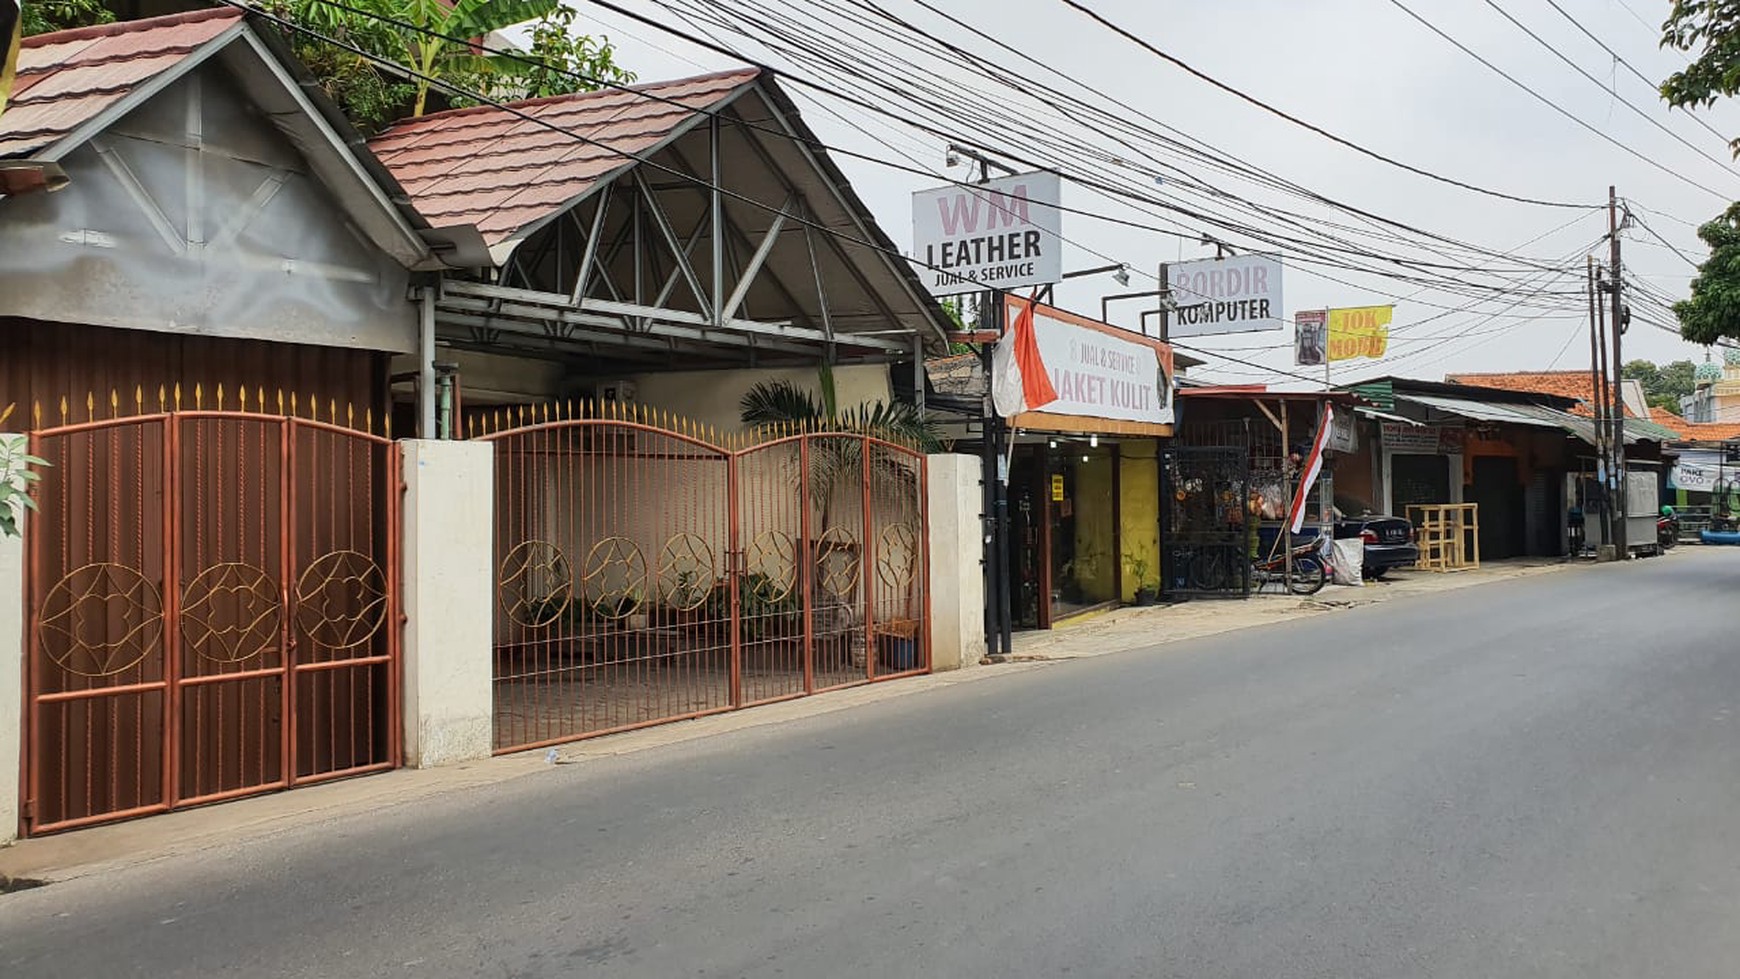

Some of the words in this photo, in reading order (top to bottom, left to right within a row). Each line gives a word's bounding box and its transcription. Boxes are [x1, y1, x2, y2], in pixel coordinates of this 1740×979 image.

[937, 185, 1029, 236] WM
[927, 230, 1041, 269] LEATHER
[935, 271, 964, 287] JUAL
[968, 270, 978, 282] &
[981, 262, 1034, 281] SERVICE
[1176, 266, 1268, 300] BORDIR
[1176, 299, 1270, 325] KOMPUTER
[1081, 343, 1099, 366] JUAL
[1108, 350, 1135, 376] SERVICE
[1110, 379, 1151, 411] KULIT
